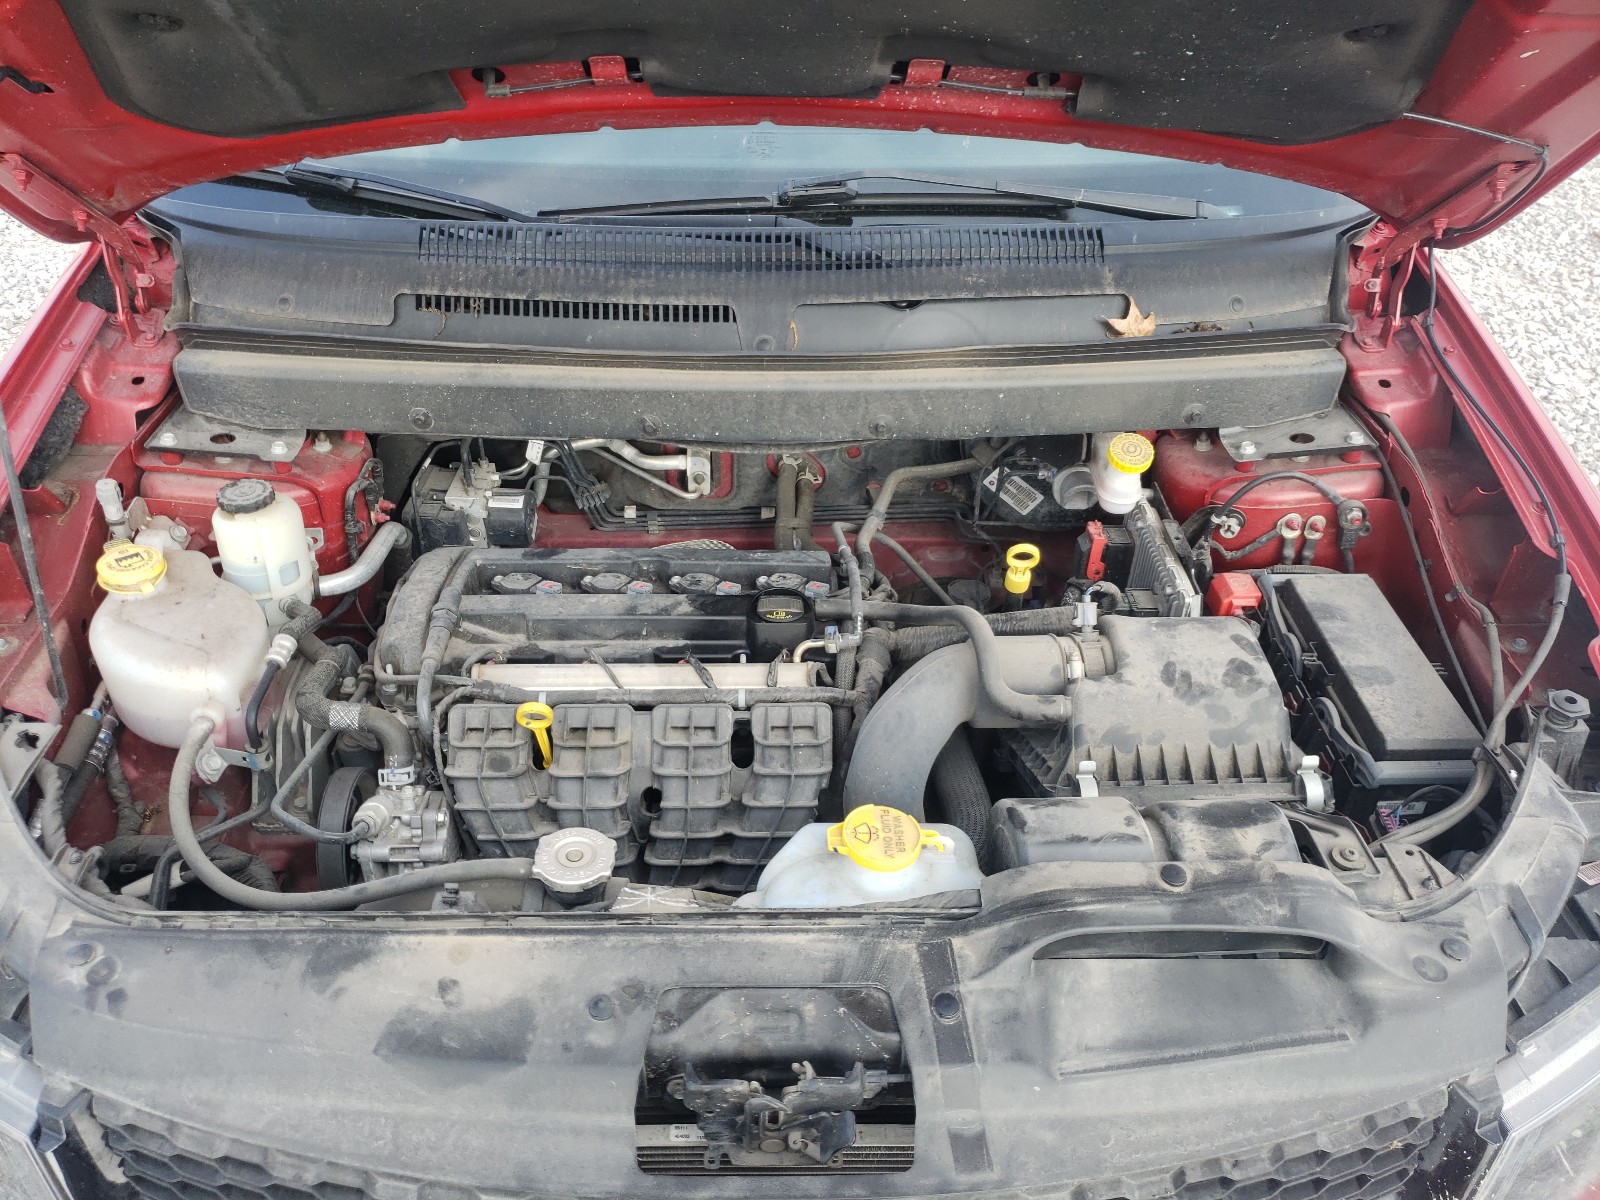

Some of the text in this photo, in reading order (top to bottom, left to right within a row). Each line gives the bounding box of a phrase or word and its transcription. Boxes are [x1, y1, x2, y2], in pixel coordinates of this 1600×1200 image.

[880, 809, 895, 859] FLUID ONLY
[892, 815, 906, 853] WASHER
